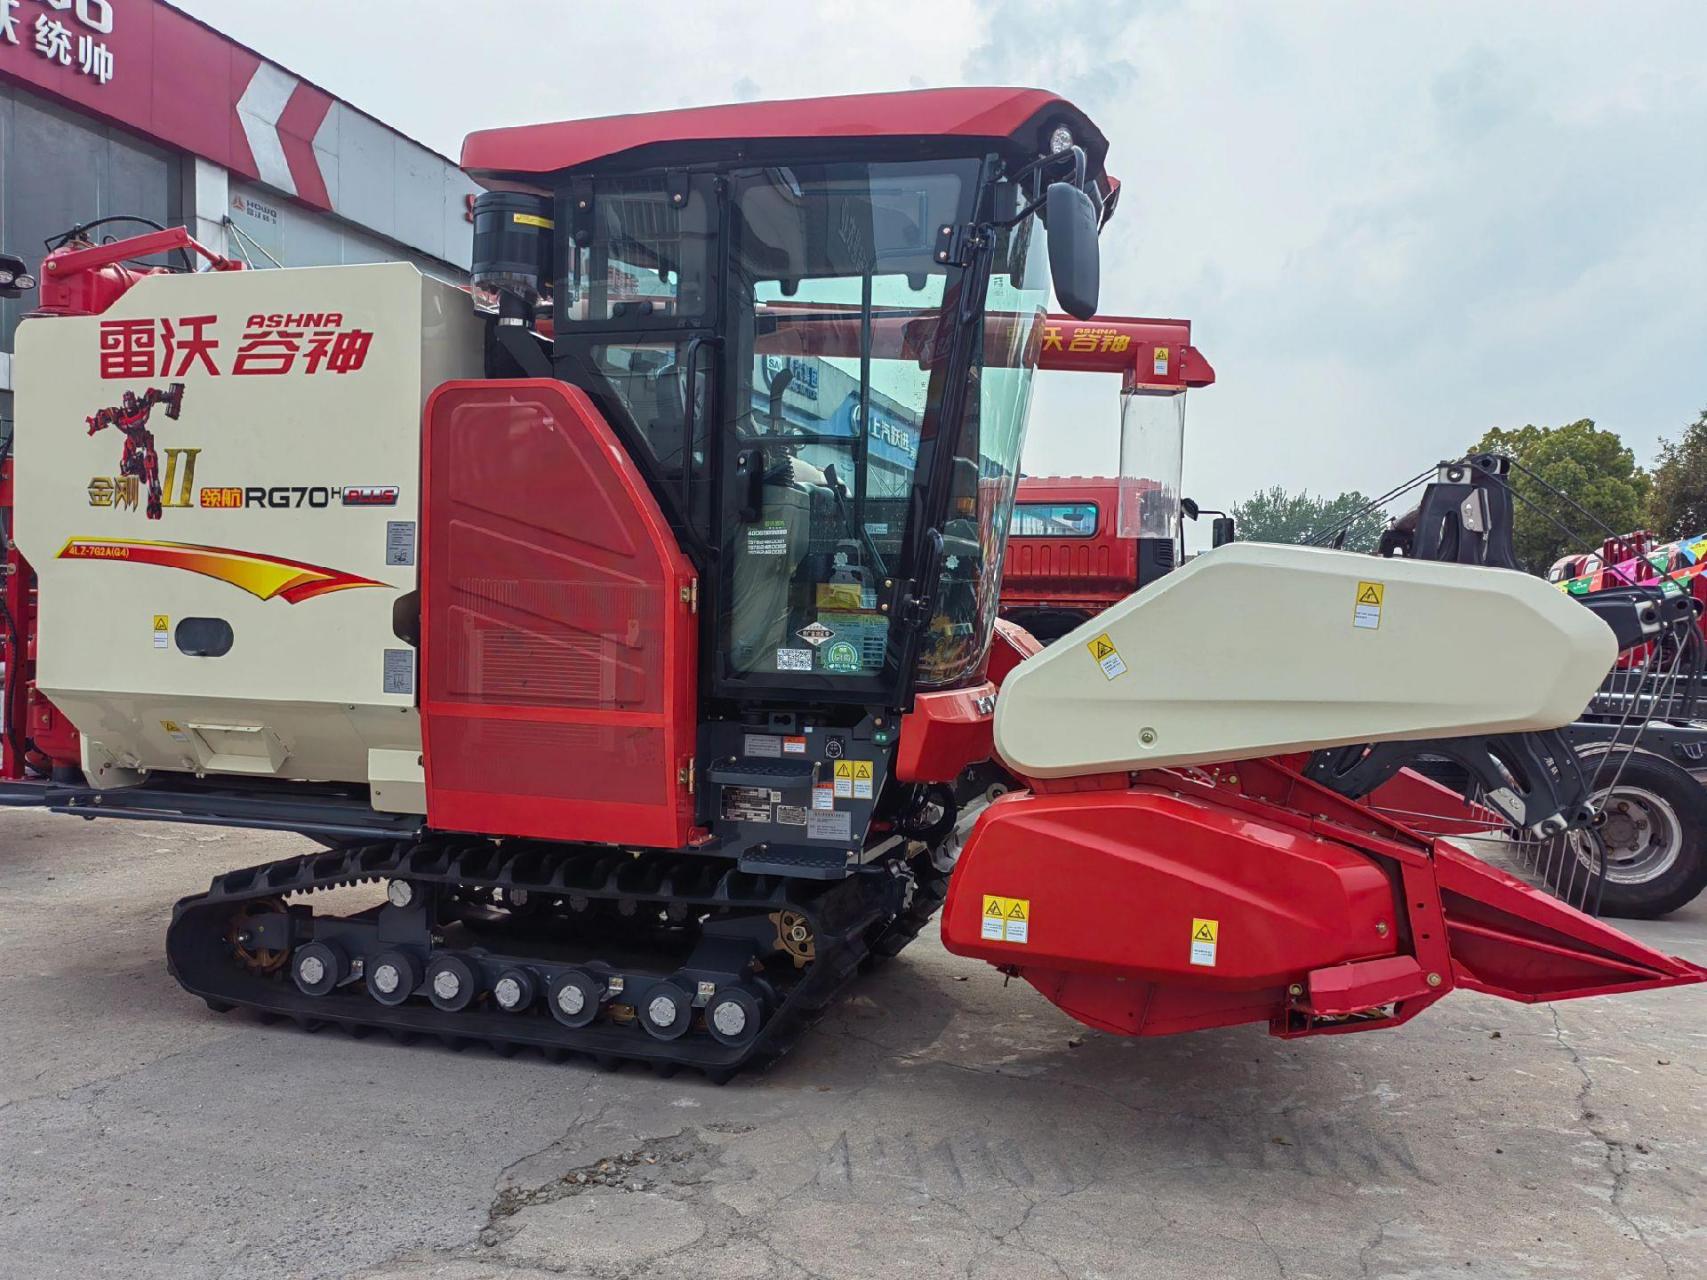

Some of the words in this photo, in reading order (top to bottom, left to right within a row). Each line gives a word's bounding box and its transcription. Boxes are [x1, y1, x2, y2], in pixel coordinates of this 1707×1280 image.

[246, 313, 343, 328] ASHNA
[202, 488, 242, 507] 领航
[346, 488, 396, 505] PLUS
